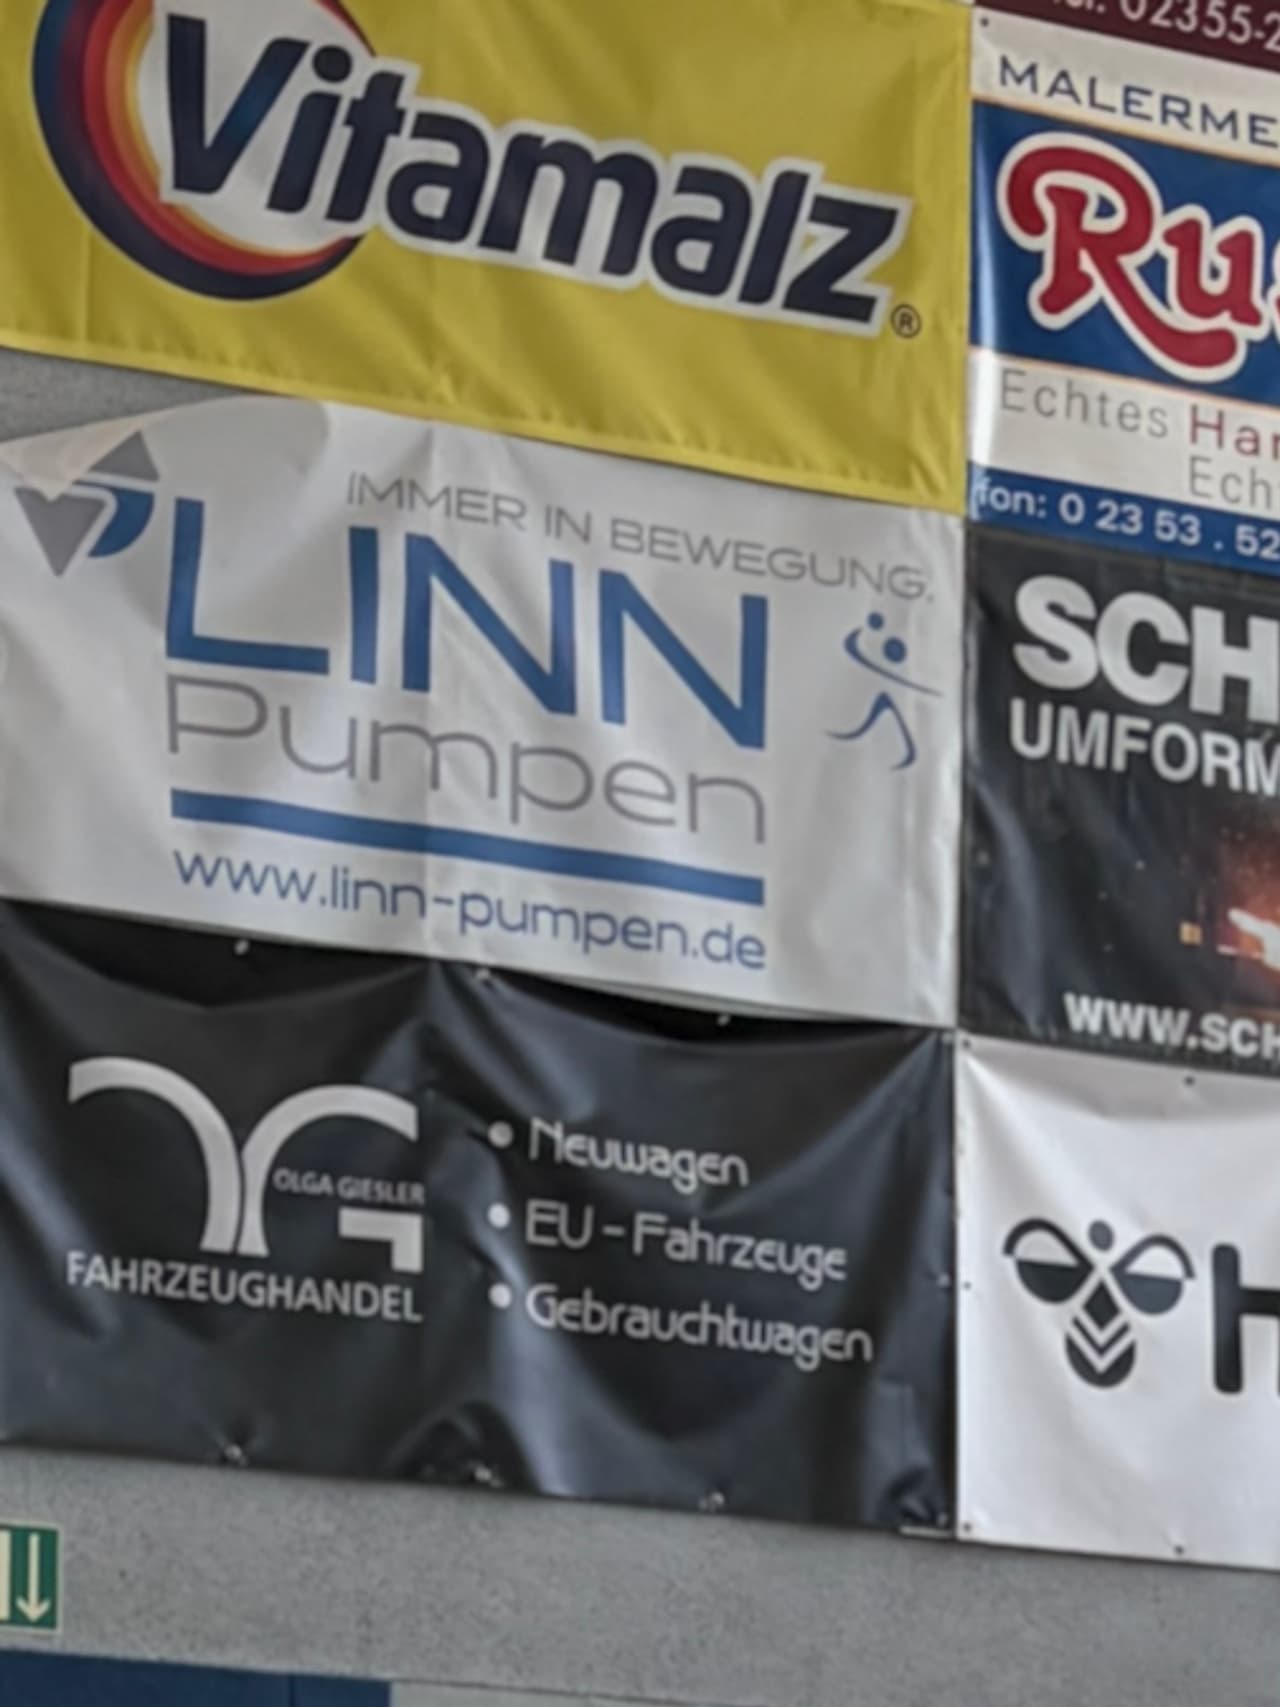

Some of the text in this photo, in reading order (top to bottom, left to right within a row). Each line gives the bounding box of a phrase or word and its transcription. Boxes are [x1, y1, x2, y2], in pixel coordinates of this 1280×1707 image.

[1000, 371, 1168, 439] Echtes
[347, 471, 934, 602] IMMER IN BEWEGUNG.
[1059, 493, 1085, 525] 0
[1095, 500, 1144, 535] 23
[1154, 509, 1202, 545] 53
[166, 498, 769, 750] LINN
[166, 674, 767, 845] Pumpen
[174, 848, 767, 971] www.linn-pumpen.de
[272, 1167, 335, 1196] OLGA
[529, 1117, 749, 1194] Neuwagen
[525, 1200, 593, 1248] EU
[633, 1214, 849, 1285] Fahrzeuge
[66, 1251, 423, 1324] FAHRZEUGHANDEL
[525, 1284, 874, 1370] Gebrauchtwagen
